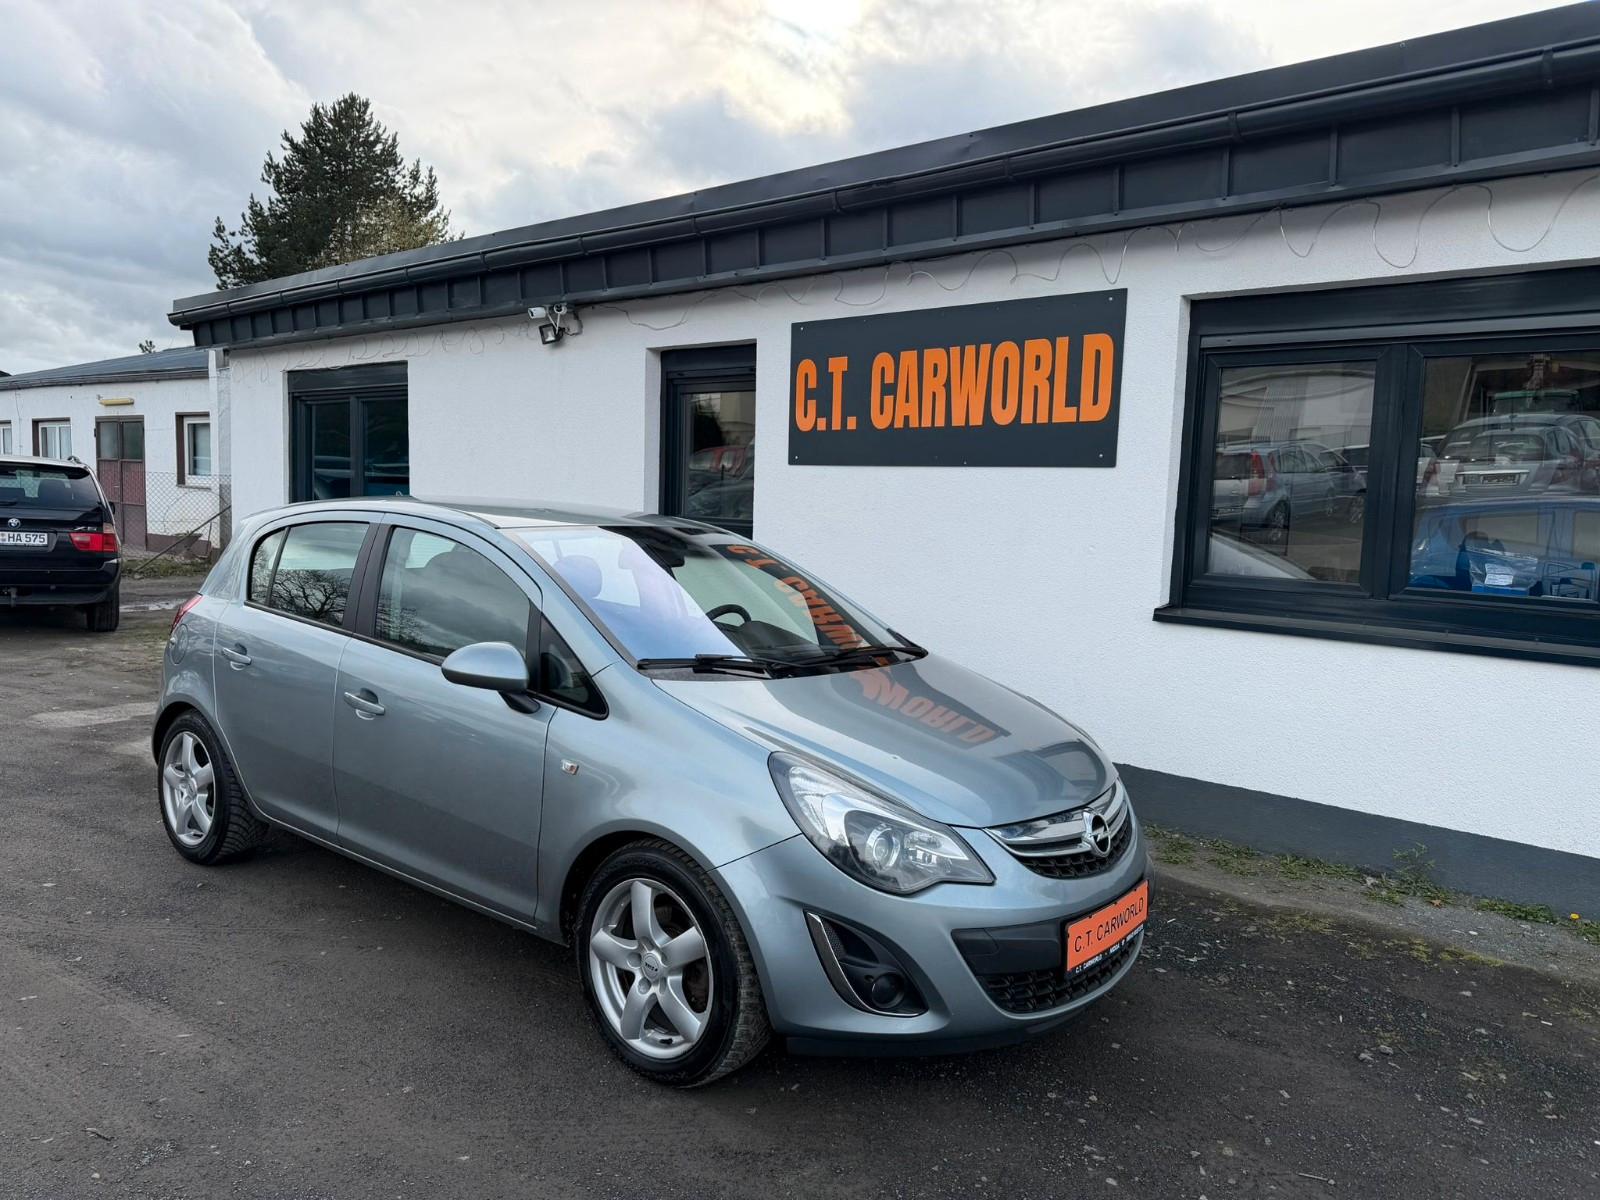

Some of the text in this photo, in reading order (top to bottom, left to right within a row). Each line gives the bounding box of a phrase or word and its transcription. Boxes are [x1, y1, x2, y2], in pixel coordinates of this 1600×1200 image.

[794, 333, 1115, 432] C.T. CARWORLD
[7, 533, 46, 544] HA 575
[1074, 930, 1093, 953] C.T.
[1096, 897, 1144, 941] CARWORLD
